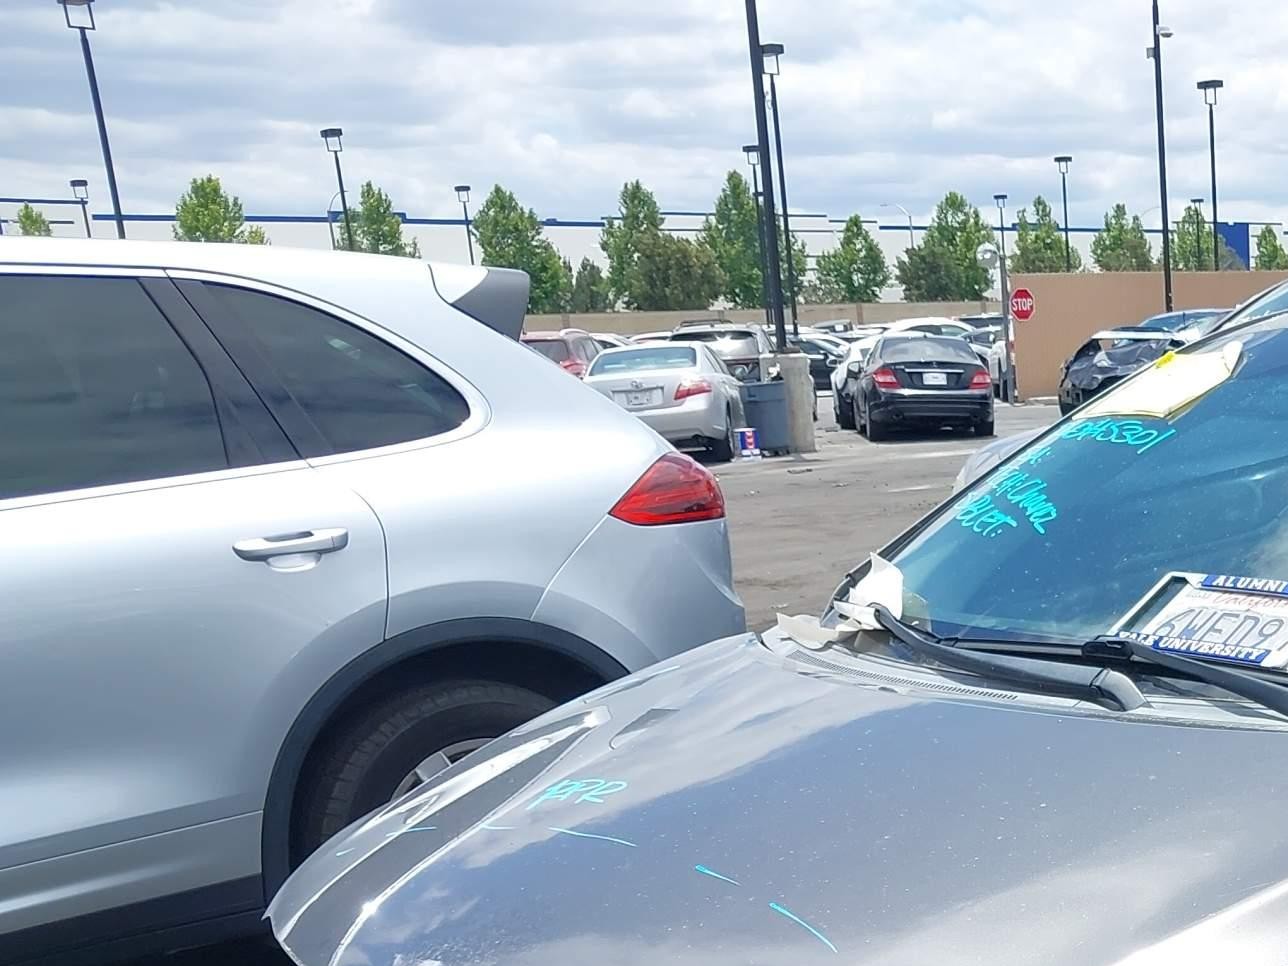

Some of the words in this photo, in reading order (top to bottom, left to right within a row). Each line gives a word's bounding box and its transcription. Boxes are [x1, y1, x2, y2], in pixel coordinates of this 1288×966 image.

[1012, 298, 1034, 311] STOP
[1212, 574, 1288, 593] ALUMNI
[1158, 636, 1267, 660] UNIVERSITY
